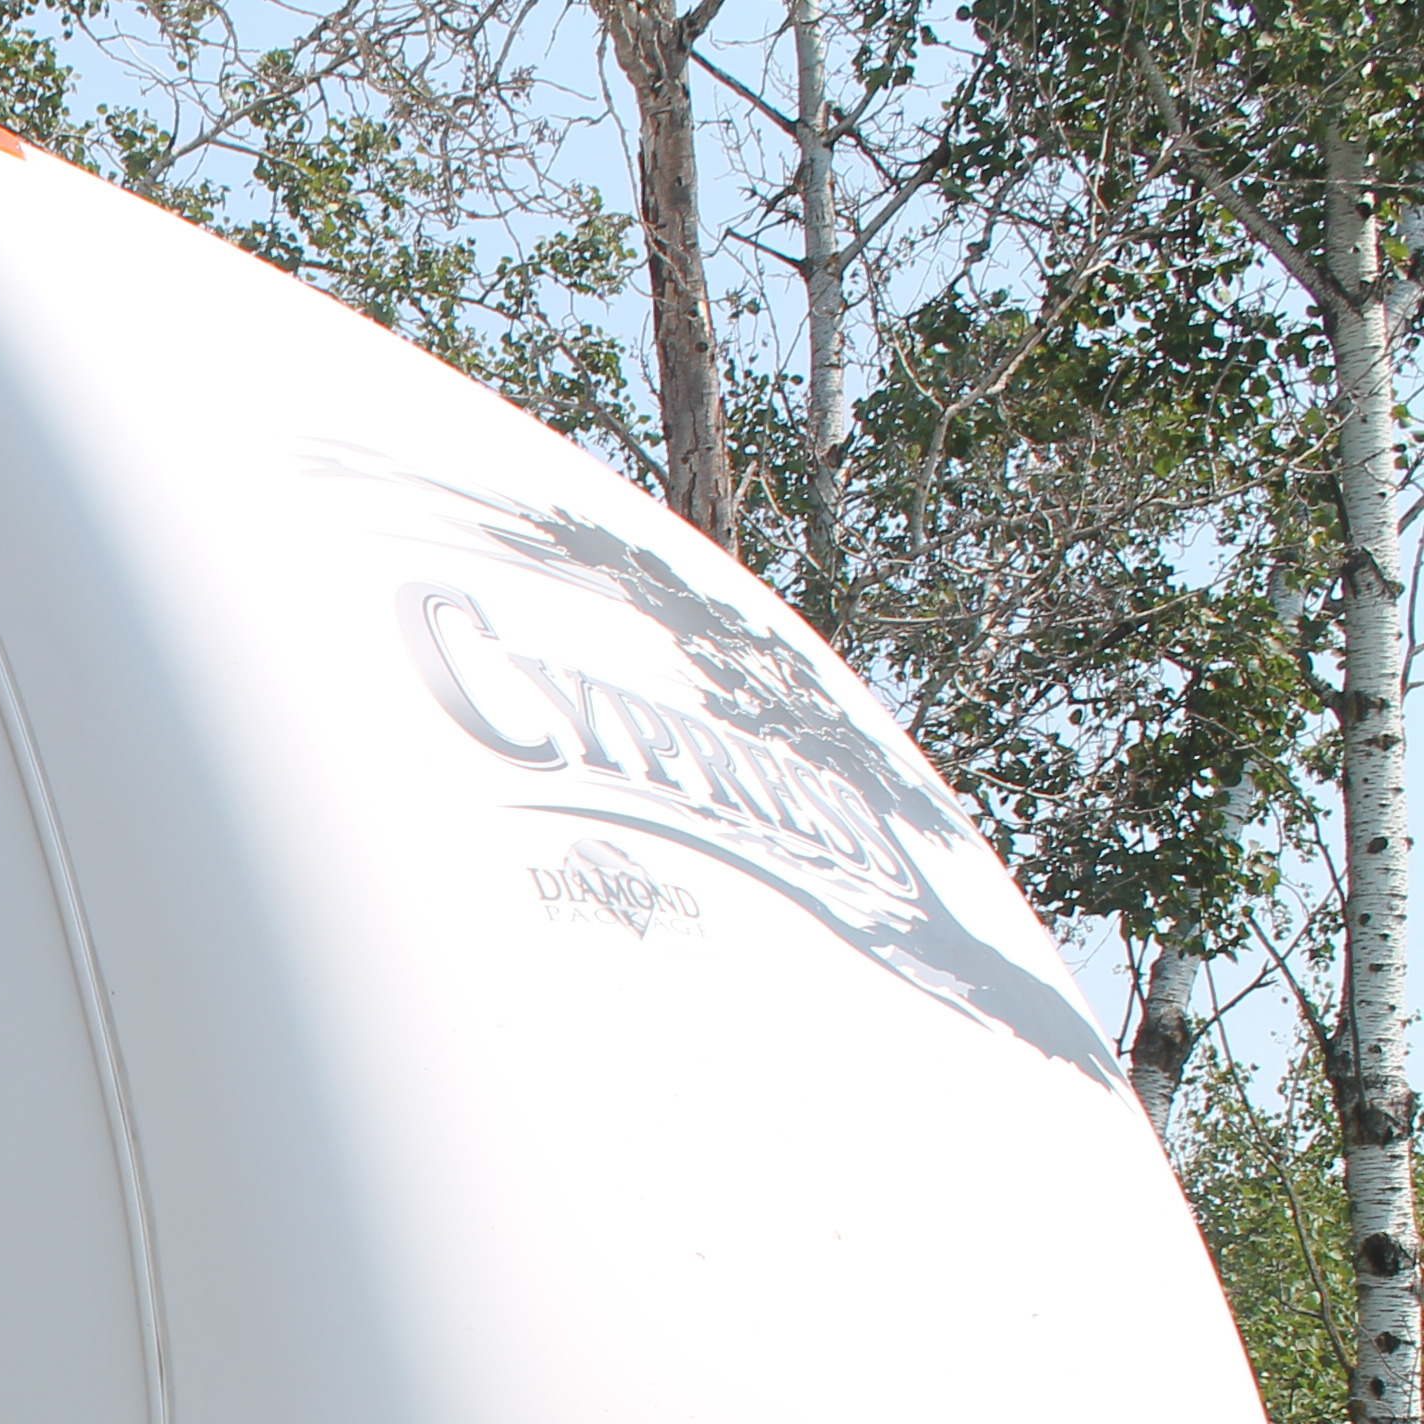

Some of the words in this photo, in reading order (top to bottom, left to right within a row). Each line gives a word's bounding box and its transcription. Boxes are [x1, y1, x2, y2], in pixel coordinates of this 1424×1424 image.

[395, 577, 919, 896] CYPRESS
[526, 866, 701, 919] DIAMOND
[544, 905, 711, 939] PACKAGE
